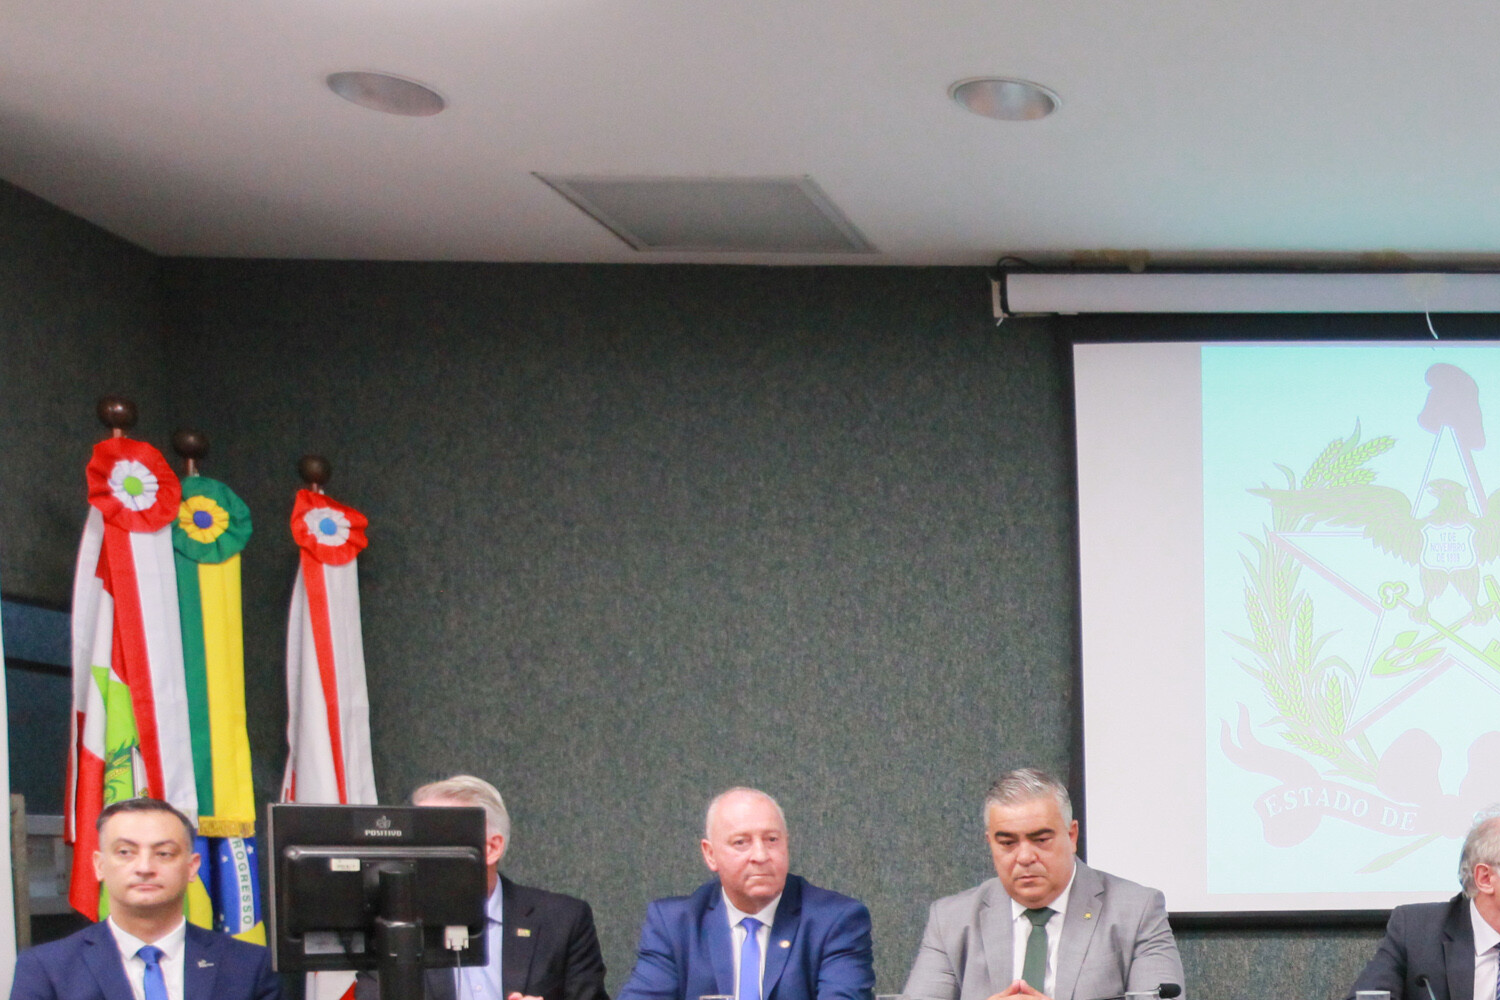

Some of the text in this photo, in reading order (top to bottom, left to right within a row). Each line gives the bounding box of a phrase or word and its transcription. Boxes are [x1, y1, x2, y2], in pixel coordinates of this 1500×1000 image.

[1263, 787, 1369, 818] ESTADO
[1380, 806, 1418, 832] DE
[364, 829, 403, 837] POSITIVO
[232, 839, 253, 925] ROGRESSO
